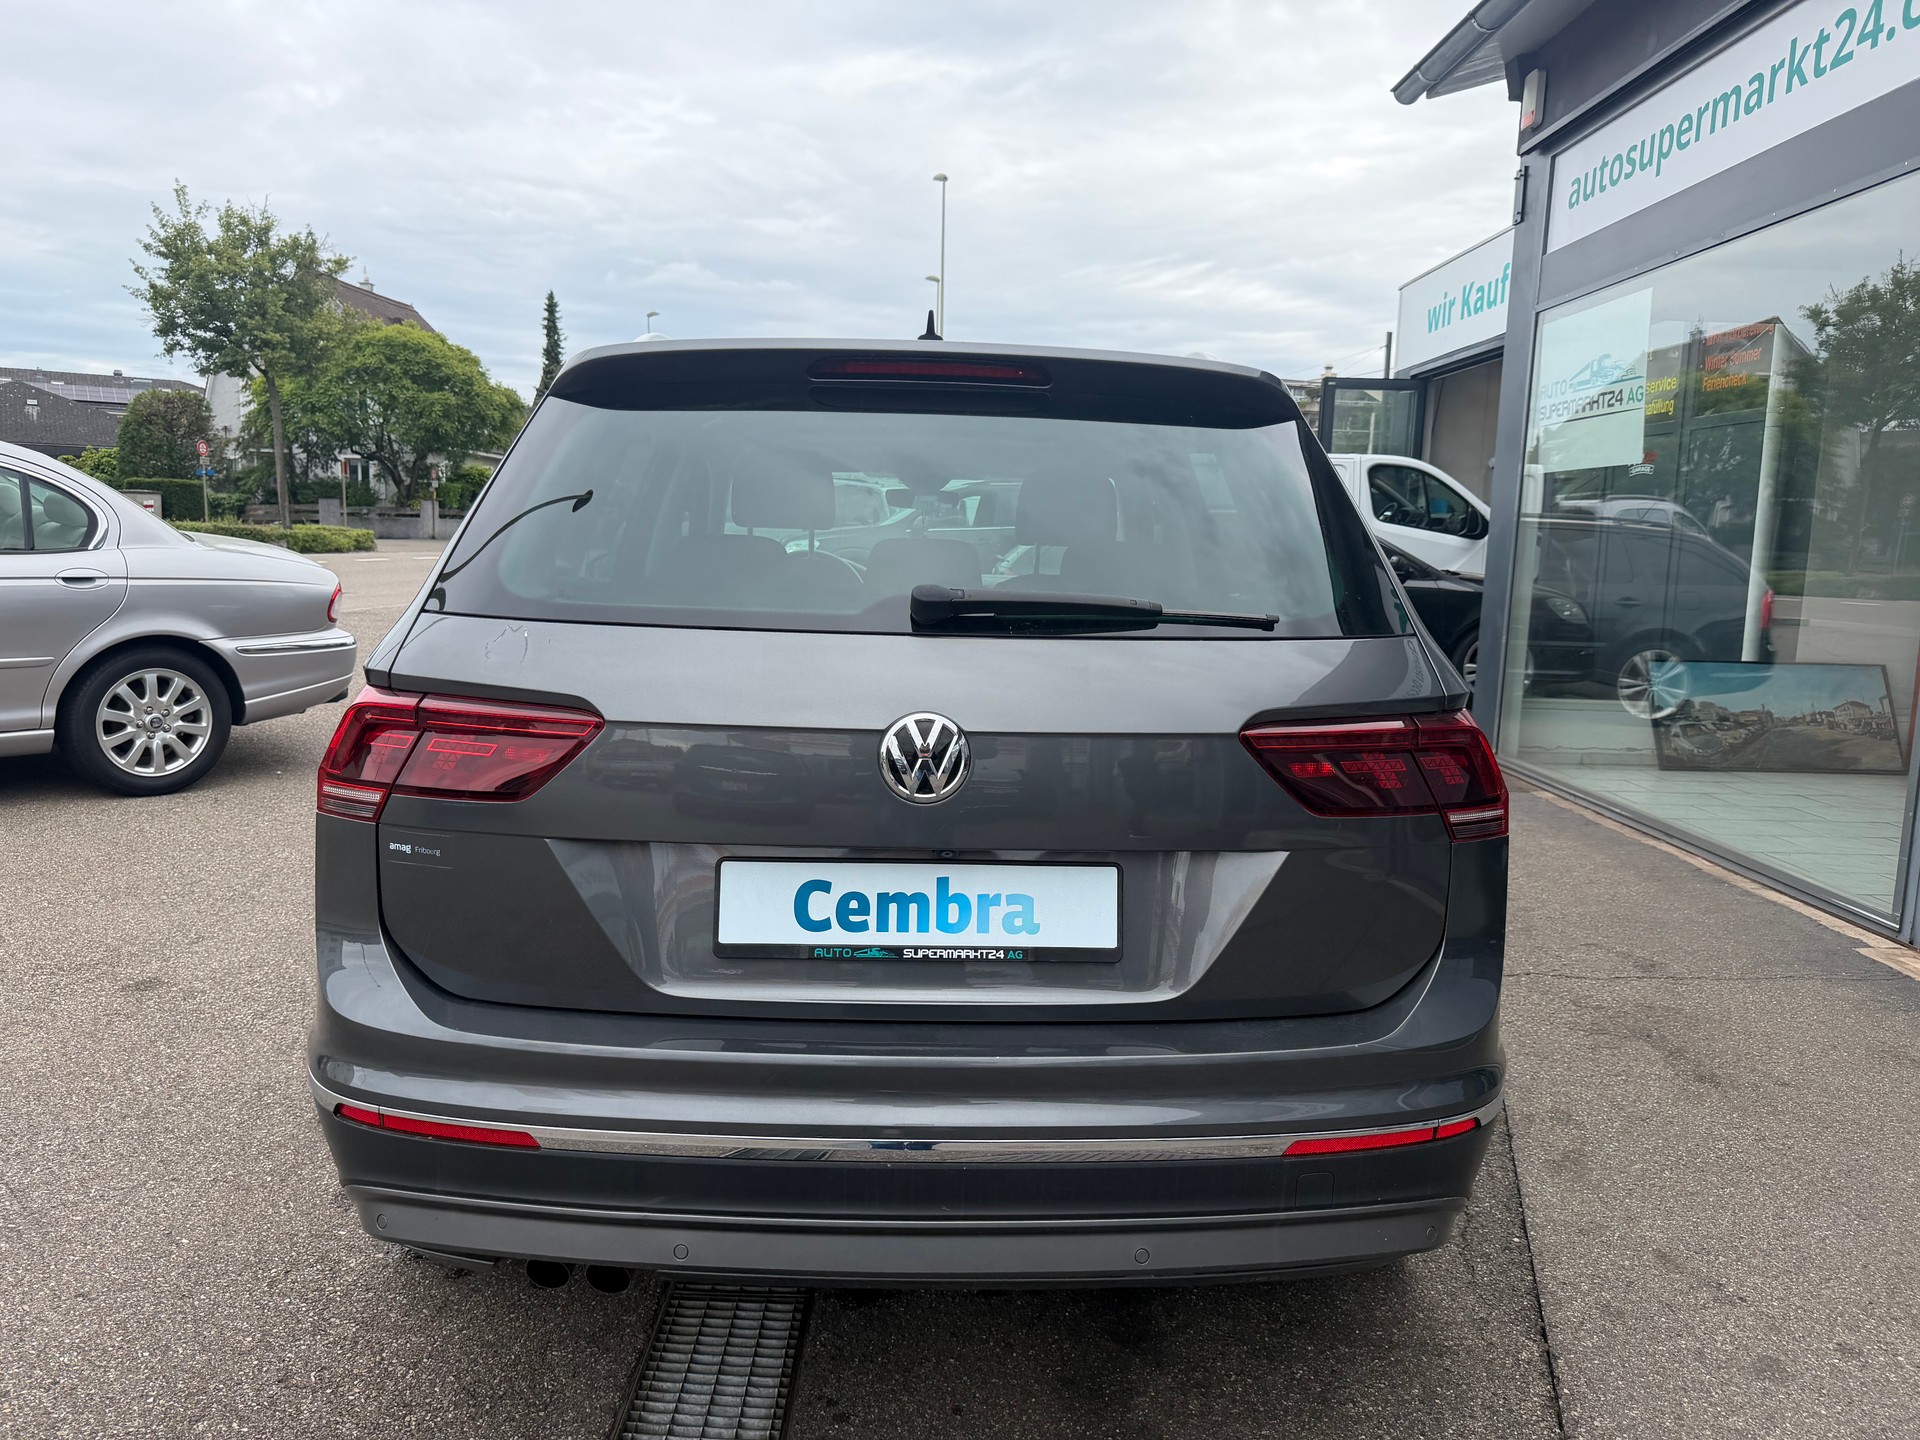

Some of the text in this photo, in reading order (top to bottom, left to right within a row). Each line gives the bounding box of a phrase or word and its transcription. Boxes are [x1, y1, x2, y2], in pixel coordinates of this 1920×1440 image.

[1427, 262, 1511, 334] wir Kauf
[1540, 379, 1568, 400] AUTO
[1626, 385, 1644, 405] AG
[389, 842, 441, 857] amag Fribourg
[793, 876, 1041, 936] Cembra
[814, 948, 1024, 960] AUTO SUPERMARKT24 AG
